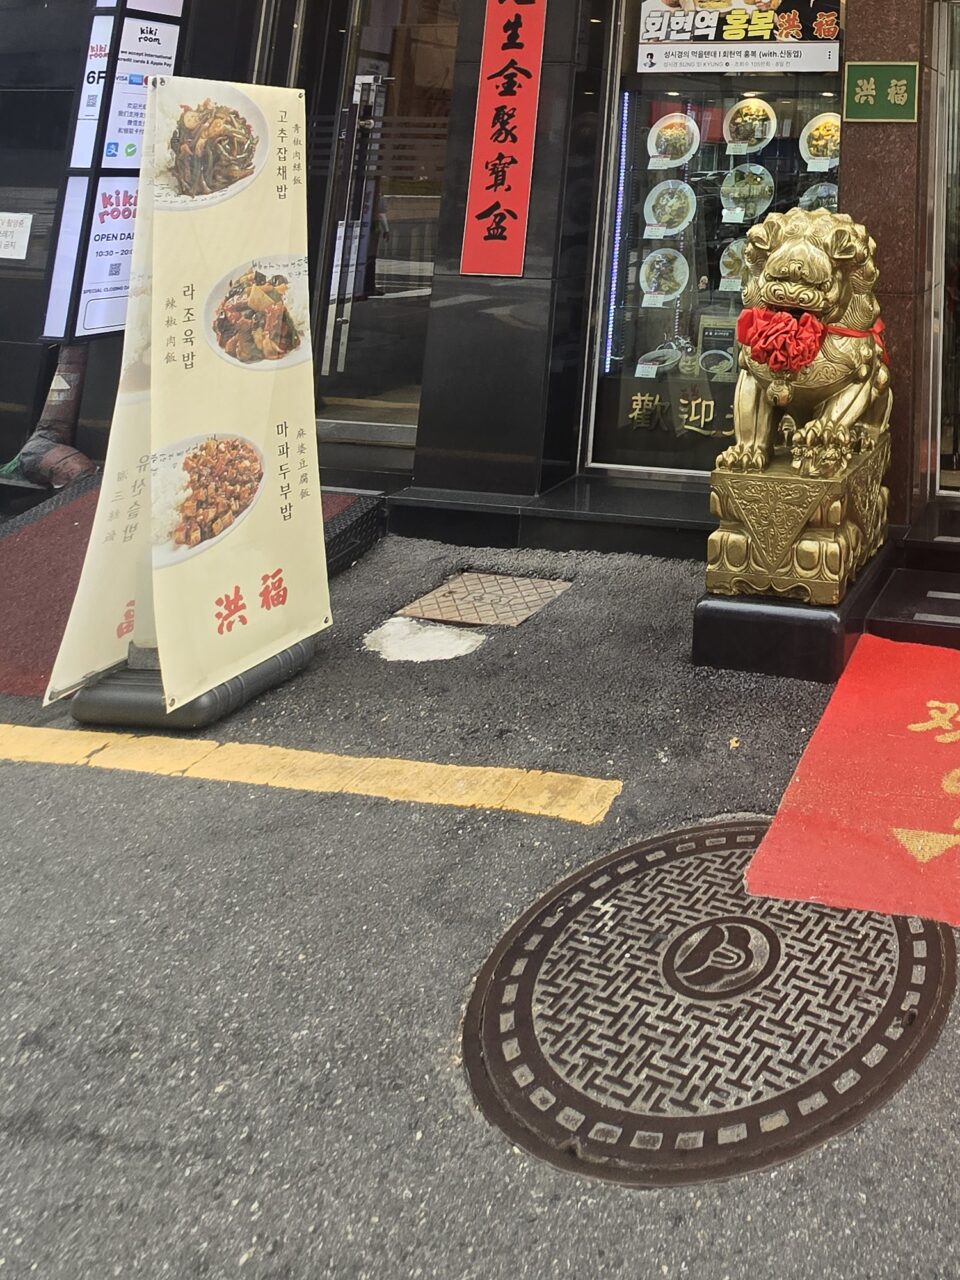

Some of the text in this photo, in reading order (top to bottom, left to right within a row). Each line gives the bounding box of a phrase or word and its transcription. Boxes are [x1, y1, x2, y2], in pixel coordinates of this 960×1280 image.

[138, 35, 162, 46] room
[140, 26, 159, 37] kiki
[641, 9, 776, 42] 회현역 홍복
[86, 70, 107, 85] 6F
[854, 77, 909, 105] 洪福
[276, 110, 289, 200] 고추잡채밥
[94, 233, 119, 242] OPEN
[182, 283, 196, 370] 라조육밥
[276, 421, 293, 521] 마파두부밥
[214, 567, 289, 635] 洪福
